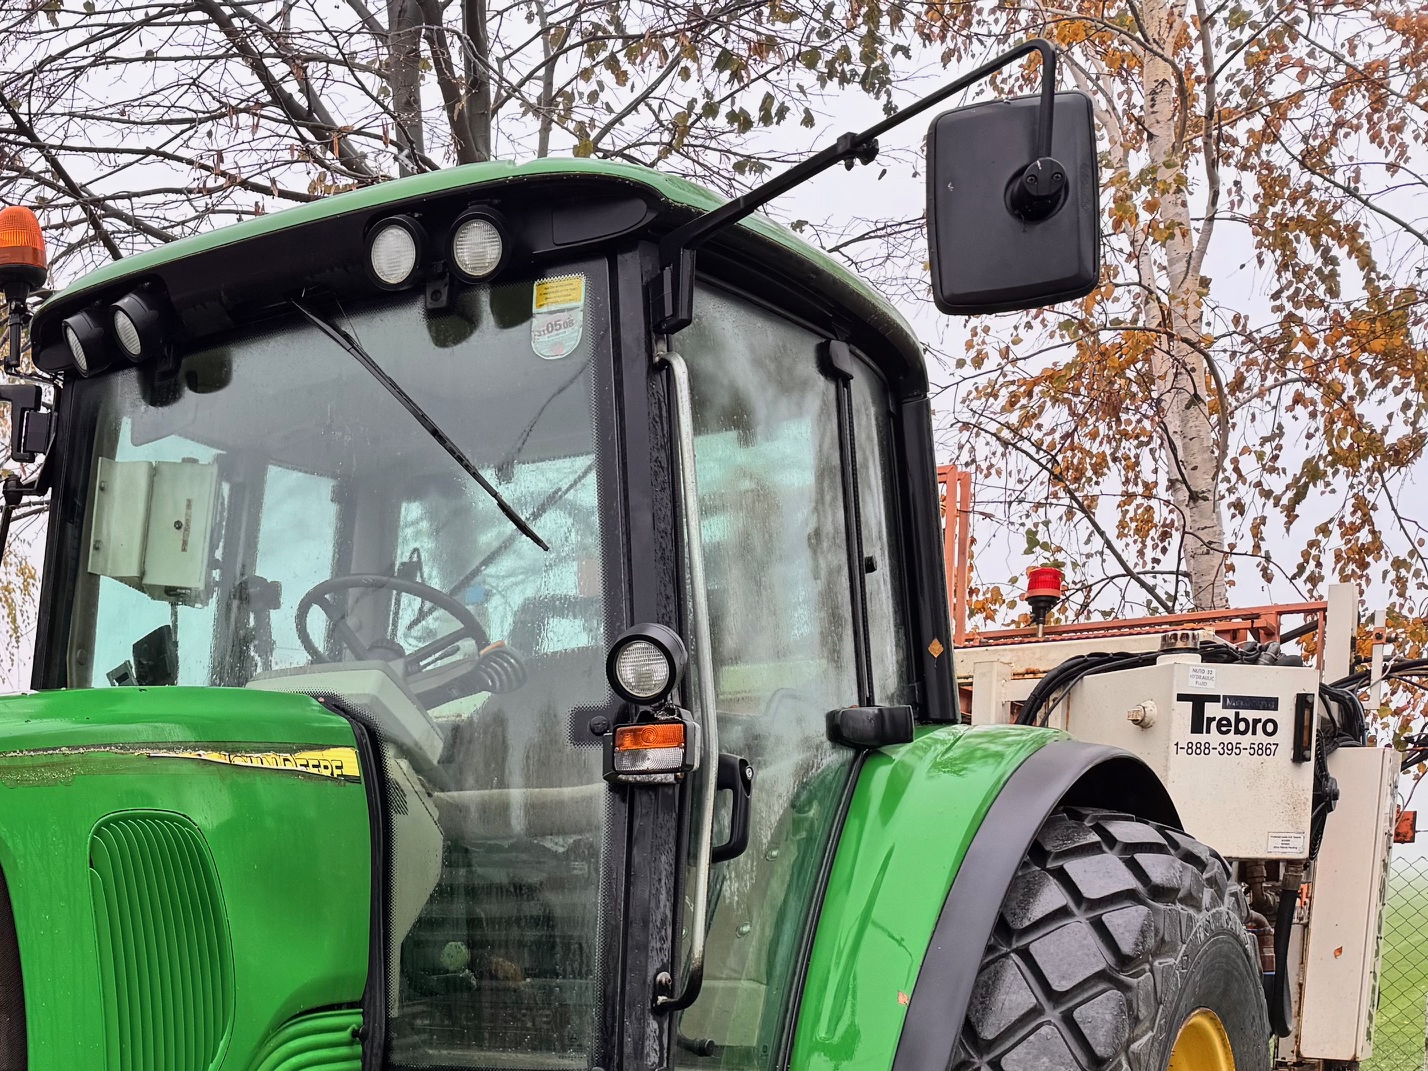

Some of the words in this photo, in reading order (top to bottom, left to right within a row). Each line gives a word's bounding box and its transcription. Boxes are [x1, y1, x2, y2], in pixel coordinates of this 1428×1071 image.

[1190, 673, 1215, 682] HYDRAULIC
[1176, 693, 1279, 738] Trebro
[1174, 741, 1279, 757] 1-888-395-5867
